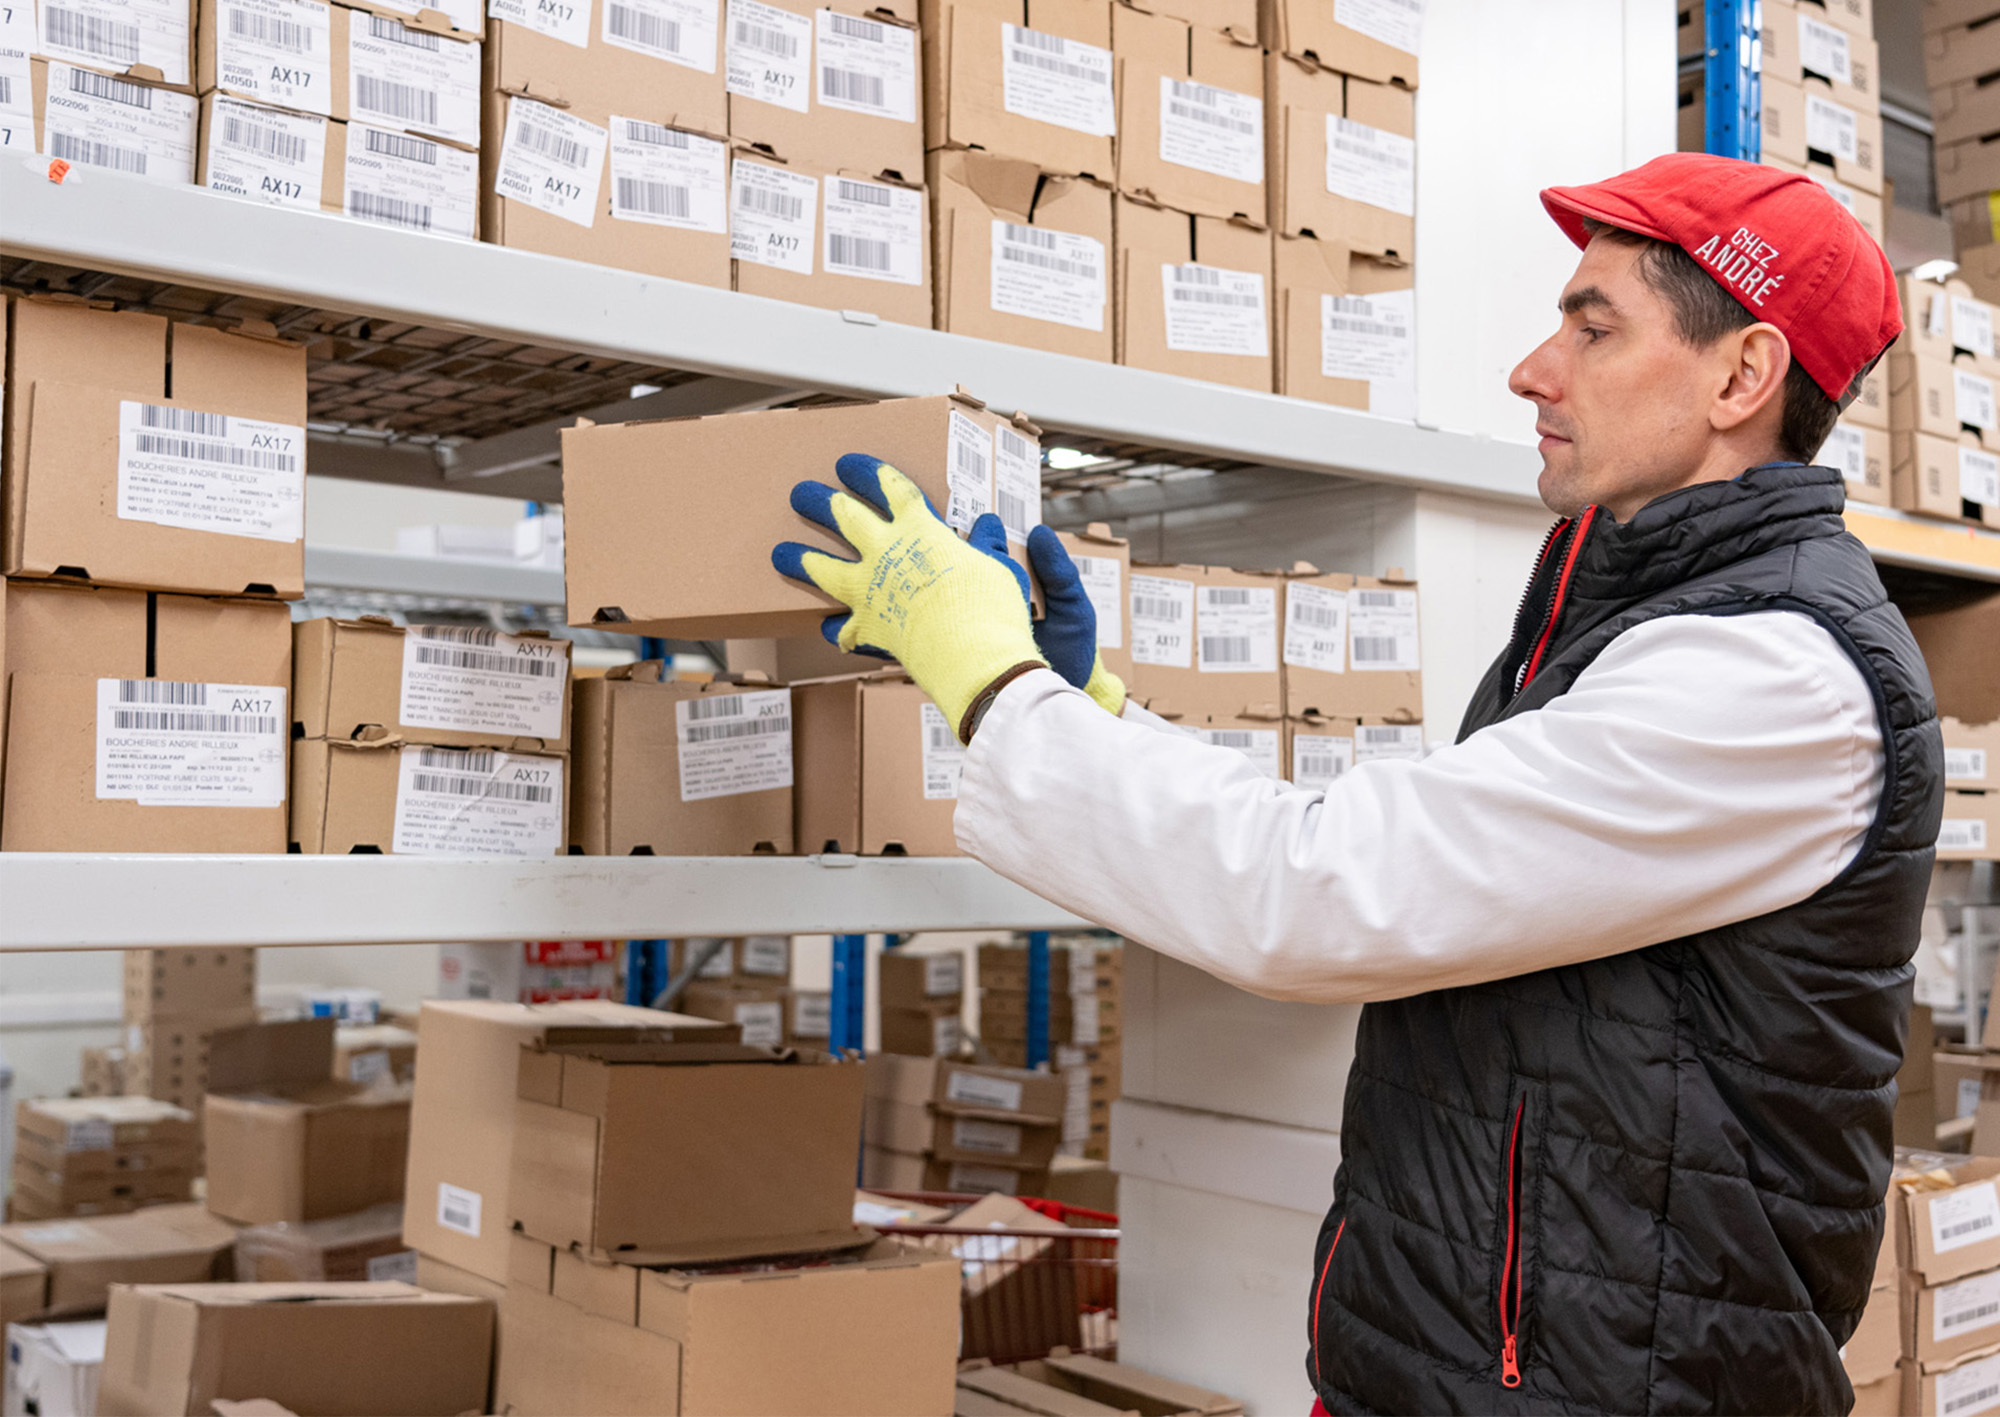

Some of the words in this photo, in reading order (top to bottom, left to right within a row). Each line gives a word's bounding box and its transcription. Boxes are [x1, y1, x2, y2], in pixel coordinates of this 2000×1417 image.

[538, 0, 573, 20] AX17
[224, 74, 258, 88] A0501
[271, 66, 311, 88] AX17
[764, 70, 794, 88] AX17
[50, 95, 89, 112] 0022006
[262, 176, 302, 198] AX17
[545, 176, 580, 200] AX17
[768, 232, 799, 252] AX17
[1730, 226, 1780, 269] CHEZ
[1694, 234, 1785, 307] ANDRÉ
[251, 434, 292, 452] AX17
[127, 460, 187, 476] BOUCHERIES
[188, 468, 219, 480] ANDRE
[221, 472, 258, 484] RILLIEUX
[158, 499, 192, 509] POITRINE
[516, 642, 552, 658] AX17
[408, 672, 460, 683] BOUCHERIES
[461, 677, 486, 686] ANDRE
[489, 680, 522, 689] RILLIEUX
[232, 698, 272, 713] AX17
[760, 703, 785, 717] AX17
[106, 738, 166, 748] BOUCHERIES
[168, 740, 198, 748] ANDRE
[202, 740, 239, 750] RILLIEUX
[137, 774, 171, 782] POITRINE
[174, 774, 198, 782] FUMEE
[514, 768, 550, 784] AX17
[405, 799, 456, 810] BOUCHERIES
[486, 806, 518, 816] RILLIEUX
